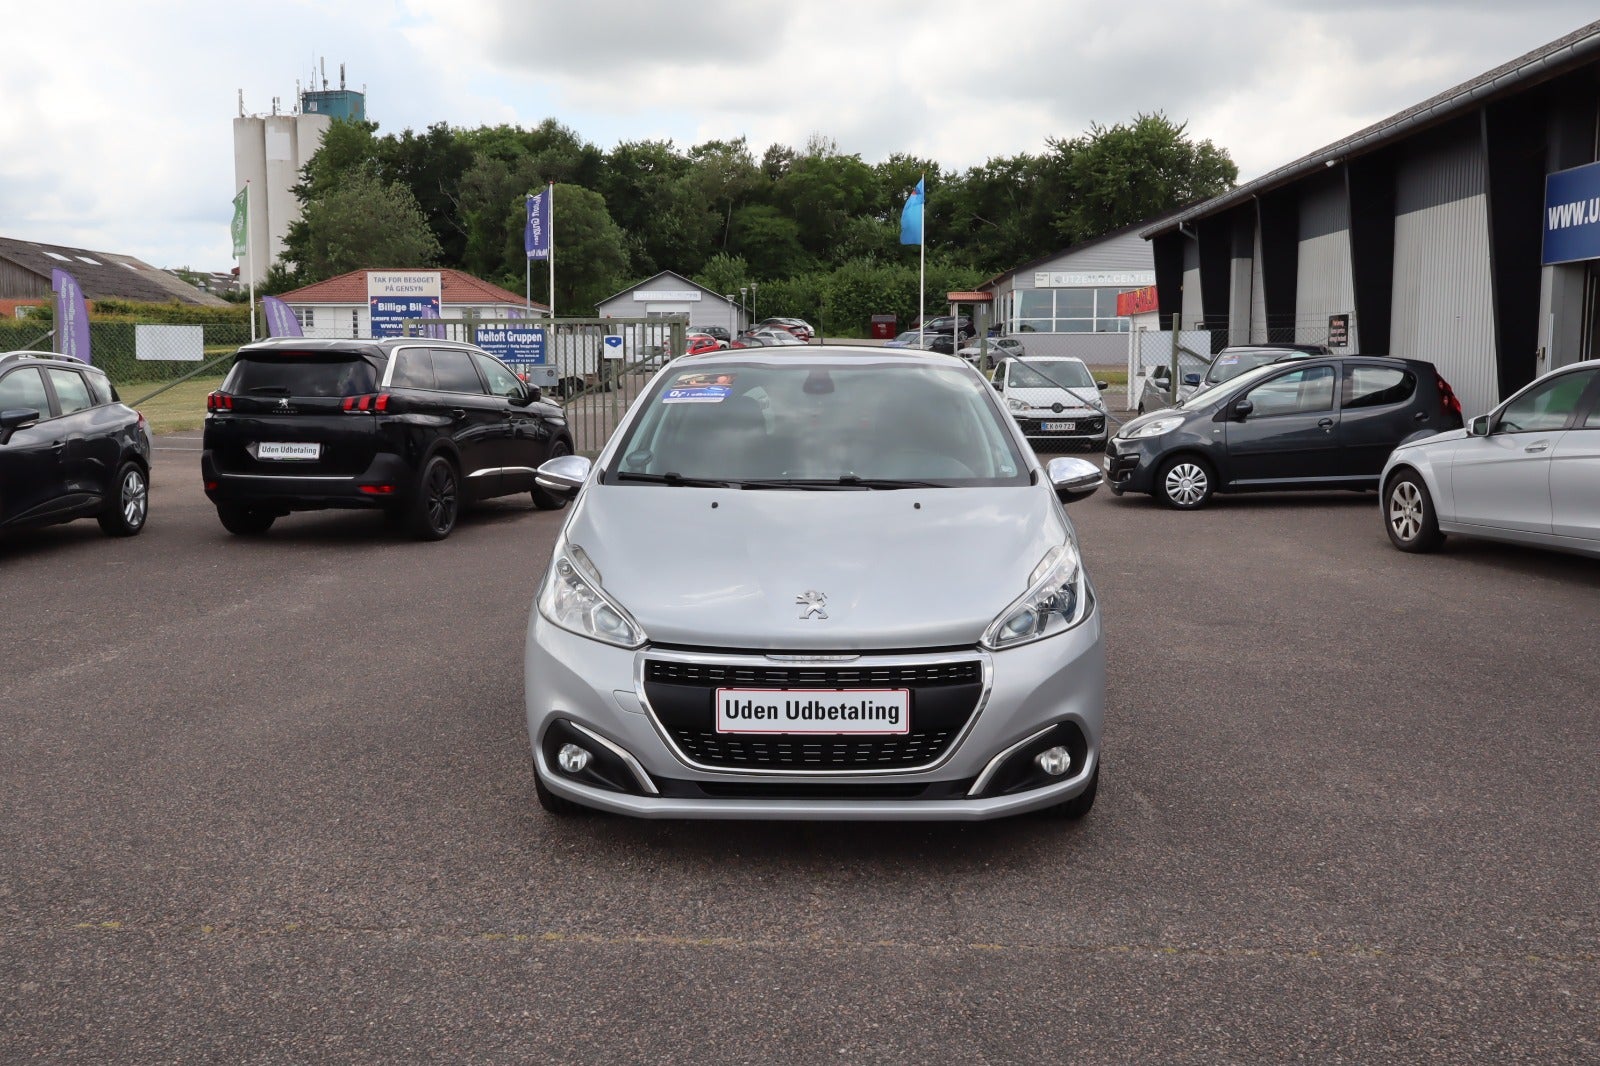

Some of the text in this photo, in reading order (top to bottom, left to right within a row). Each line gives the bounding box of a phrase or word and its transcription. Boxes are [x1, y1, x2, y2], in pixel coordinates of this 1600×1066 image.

[1548, 197, 1600, 231] WWW.U
[385, 284, 394, 292] PÅ
[378, 302, 407, 312] Billige
[478, 331, 542, 344] Neltoft Gruppen
[280, 446, 317, 455] Udbetaling
[725, 699, 900, 725] Uden Udbetaling
